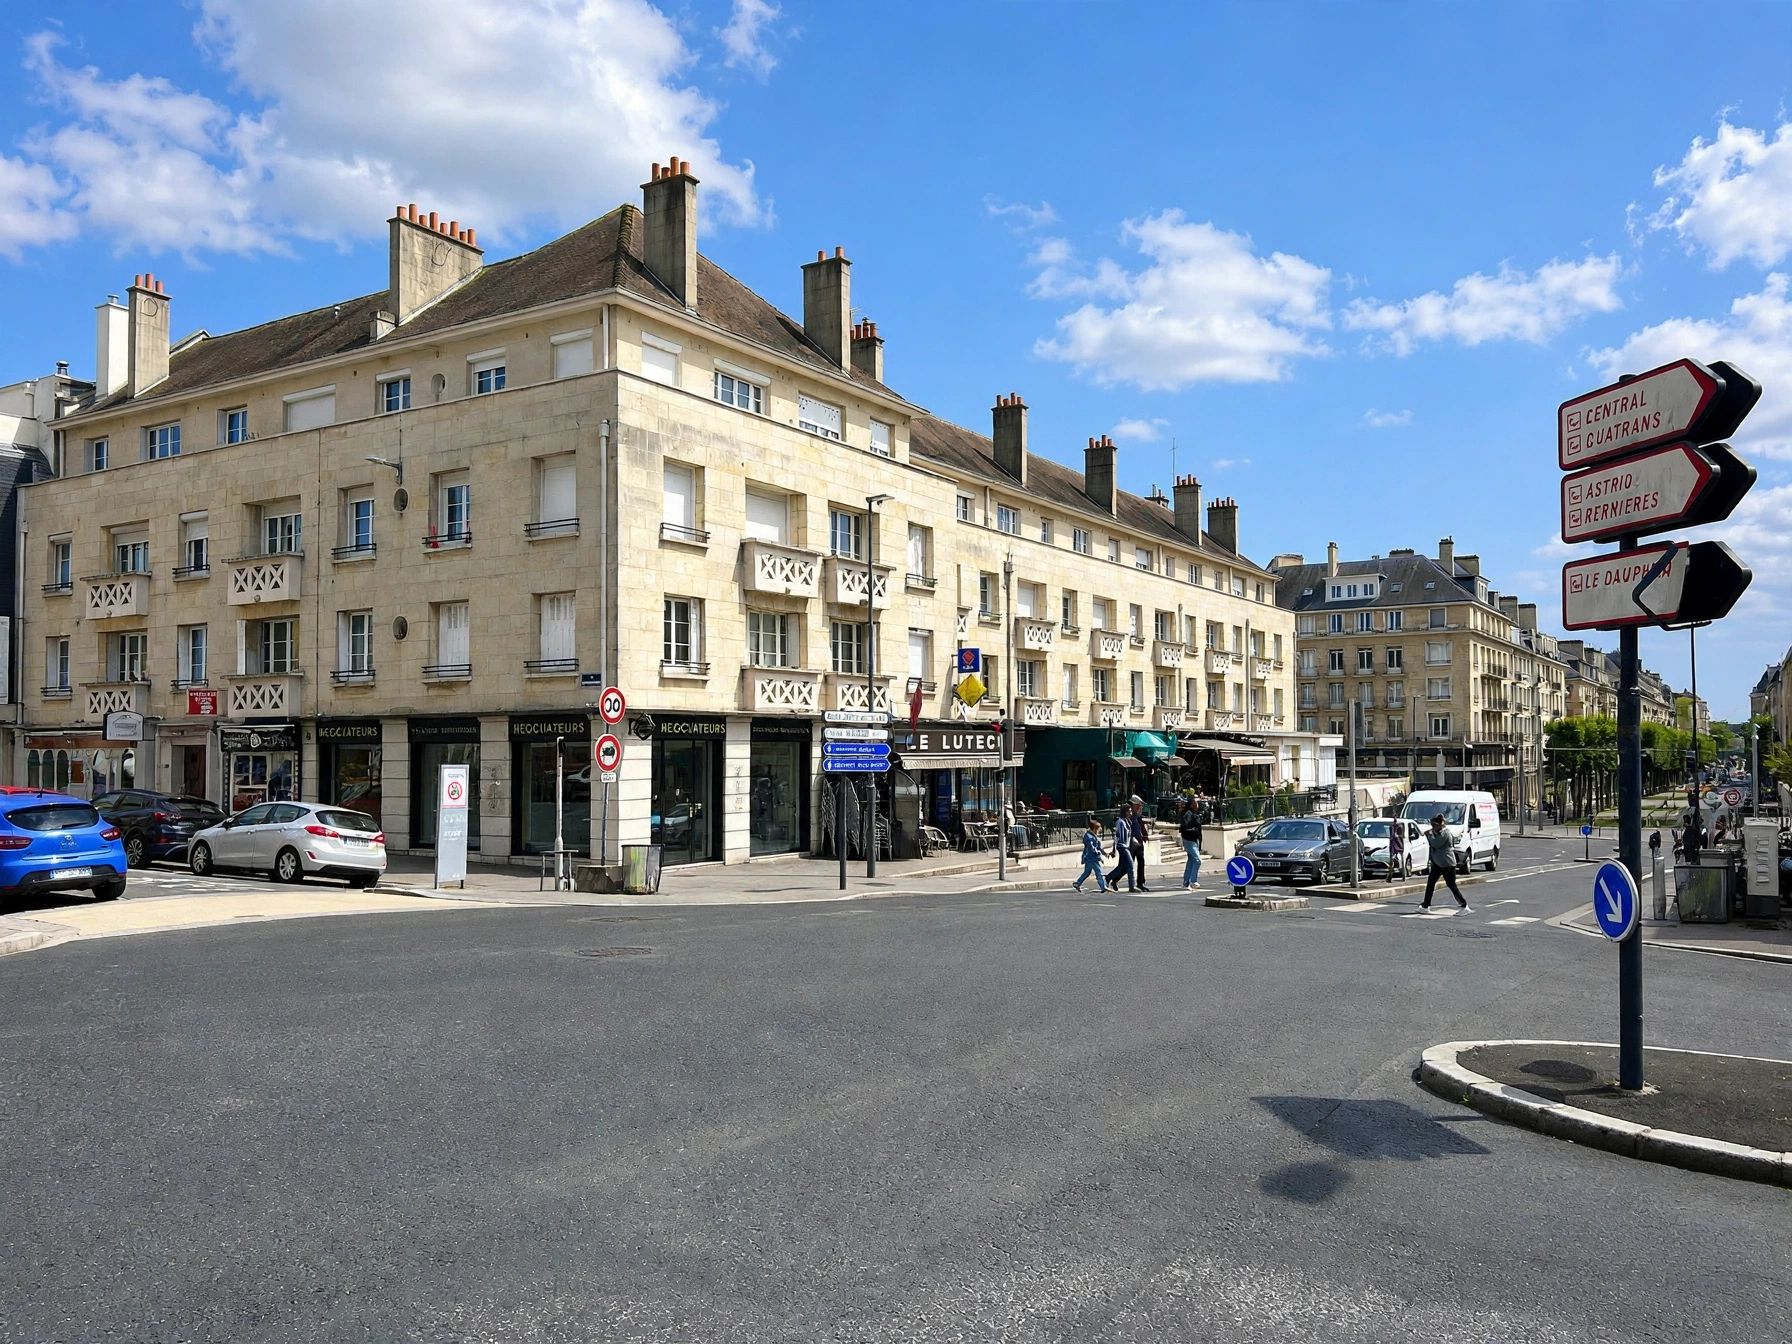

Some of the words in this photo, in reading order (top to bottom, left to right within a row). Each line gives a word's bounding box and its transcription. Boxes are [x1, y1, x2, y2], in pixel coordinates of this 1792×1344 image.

[1586, 390, 1647, 425] CENTRAL
[1585, 572, 1600, 589] LE
[942, 734, 1000, 750] LUTEC
